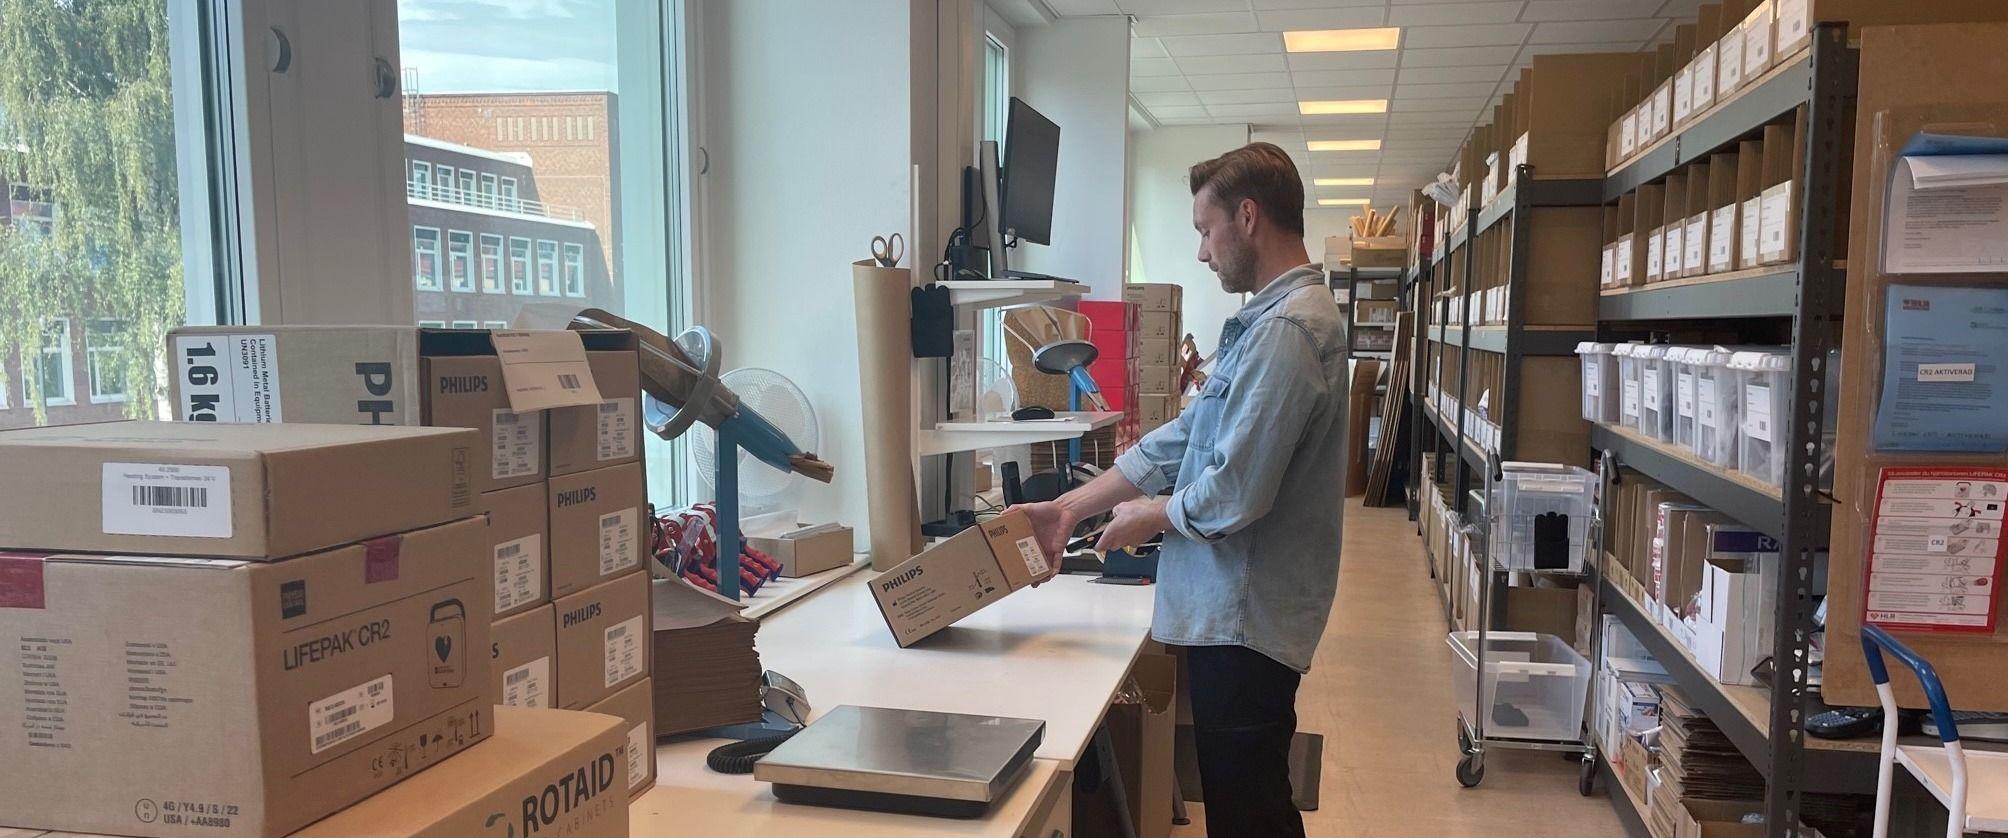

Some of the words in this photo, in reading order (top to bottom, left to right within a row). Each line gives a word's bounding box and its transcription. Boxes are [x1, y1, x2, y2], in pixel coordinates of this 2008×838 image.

[186, 342, 218, 386] 1.6
[240, 339, 249, 369] UN3091
[250, 338, 258, 380] Contained
[259, 338, 267, 368] Lithium
[440, 376, 488, 394] PHILIPS
[557, 487, 596, 508] PHILIPS
[988, 524, 1008, 540] PHILIPS
[882, 565, 924, 592] PHILIPS
[563, 602, 602, 628] PHILIPS
[284, 630, 354, 670] LIFEPAK
[358, 618, 391, 646] CR2
[522, 752, 615, 838] ROTAID
[164, 814, 182, 824] USA
[227, 806, 239, 815] 22
